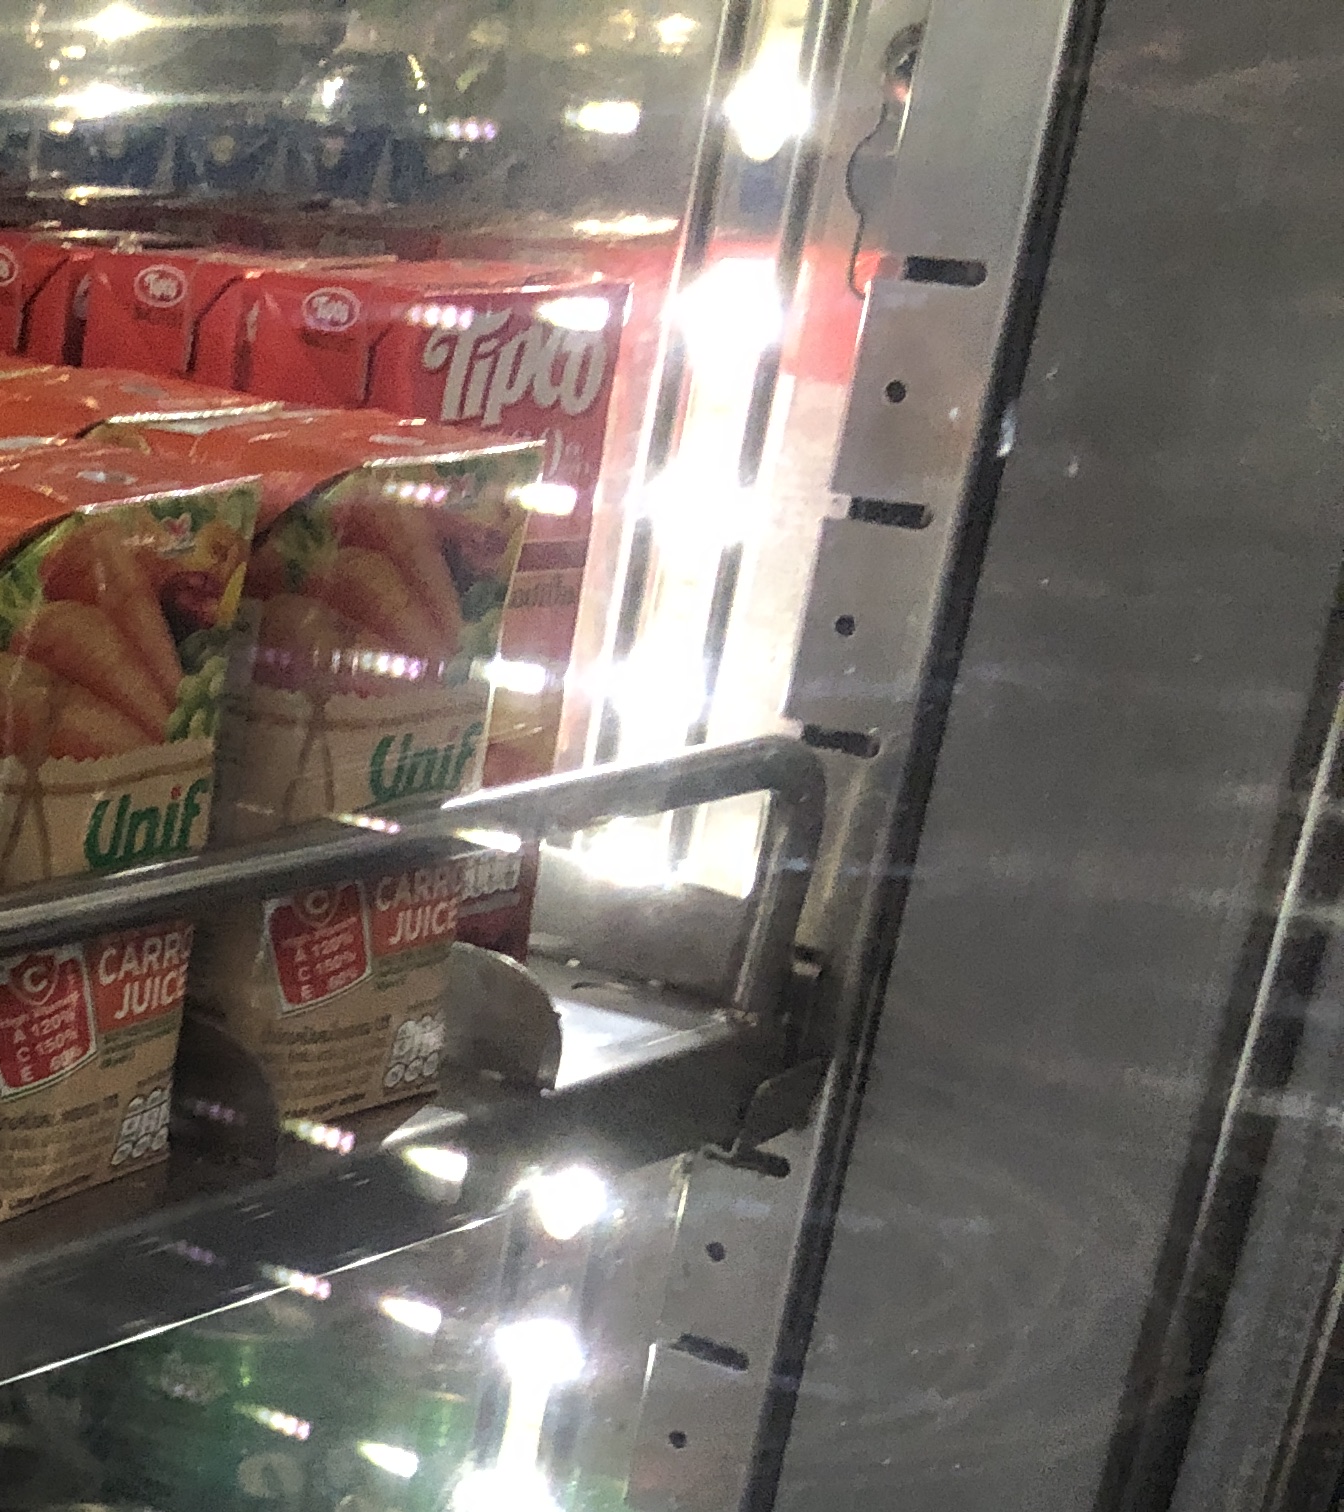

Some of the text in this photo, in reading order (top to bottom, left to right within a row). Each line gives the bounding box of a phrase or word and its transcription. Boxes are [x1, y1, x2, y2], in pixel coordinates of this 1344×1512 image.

[422, 306, 608, 428] Tipco
[369, 720, 485, 799] Unif
[83, 777, 212, 872] Unif
[23, 965, 48, 994] C
[16, 1045, 32, 1063] C
[19, 1063, 35, 1082] E
